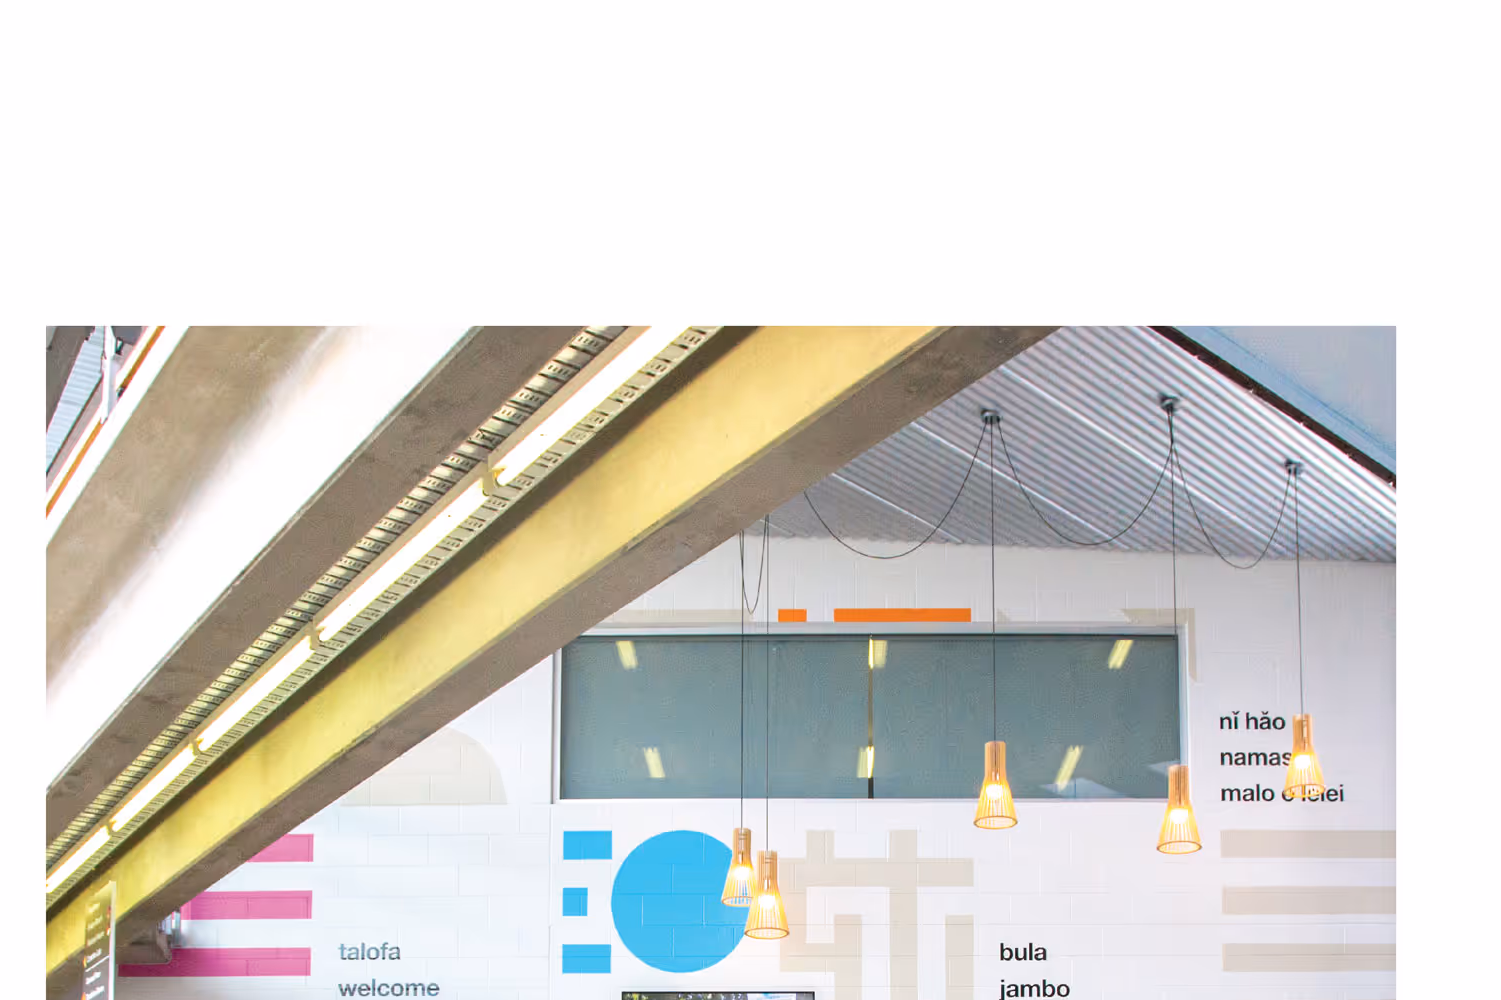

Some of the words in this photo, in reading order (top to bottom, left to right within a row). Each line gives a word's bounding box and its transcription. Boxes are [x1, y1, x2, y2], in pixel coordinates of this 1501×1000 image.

[1220, 751, 1292, 767] namas
[1220, 783, 1276, 802] malo
[338, 942, 401, 961] talofa
[999, 942, 1048, 962] bula
[338, 978, 440, 997] welcome
